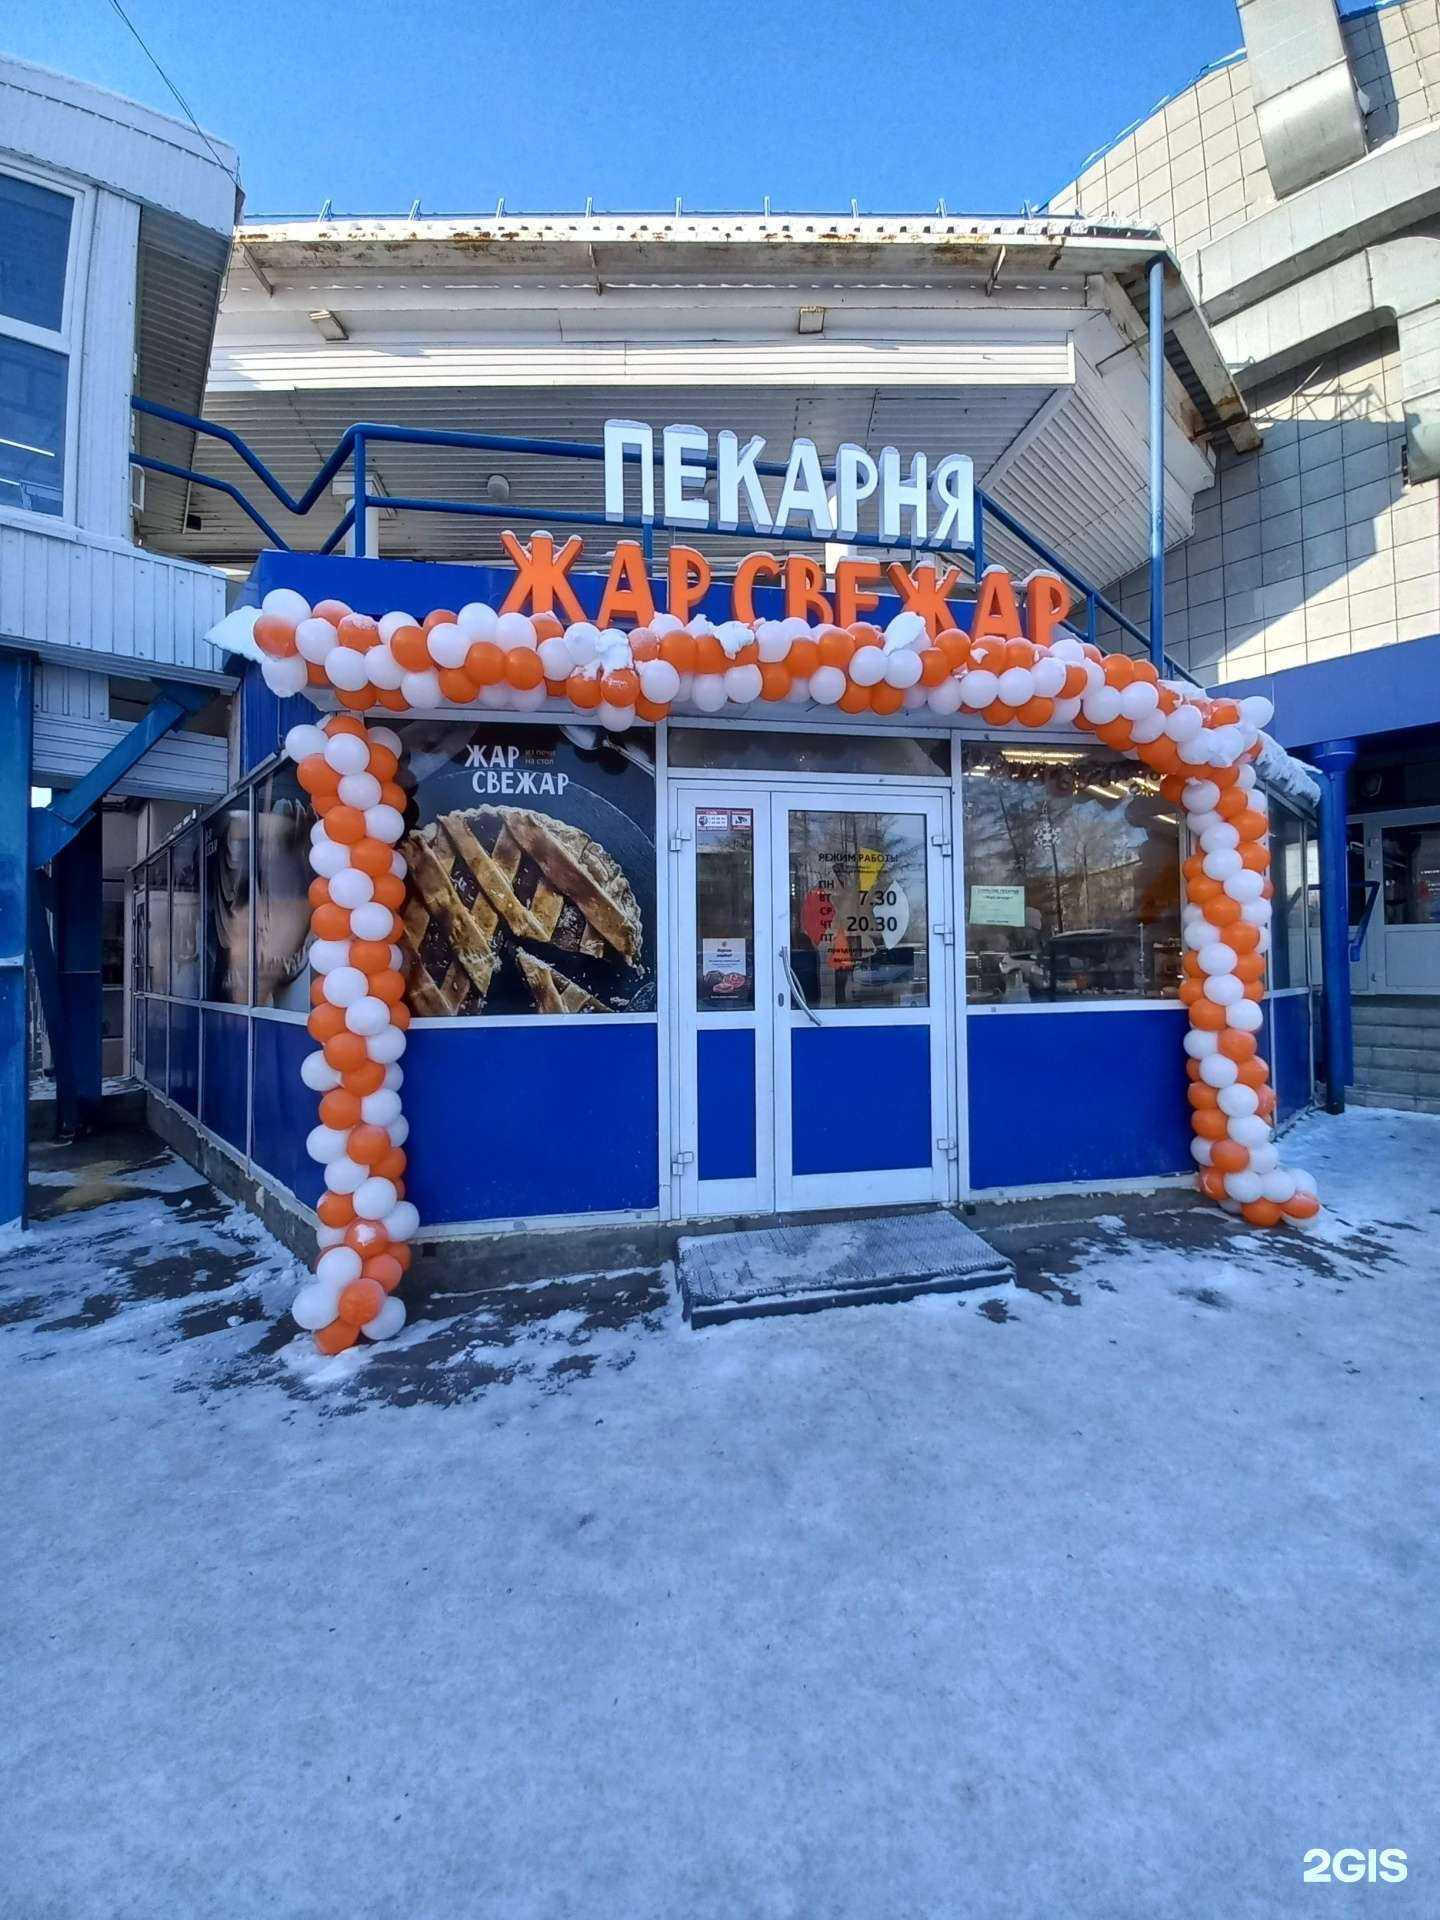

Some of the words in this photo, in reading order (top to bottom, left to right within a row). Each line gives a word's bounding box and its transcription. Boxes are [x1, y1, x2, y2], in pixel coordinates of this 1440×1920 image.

[604, 419, 975, 551] ПЕКАРНЯ
[499, 529, 711, 629] ЖАР
[464, 744, 520, 769] ЖАР
[472, 770, 570, 796] СВЕЖАР
[818, 853, 856, 862] РЕЖИМ
[858, 854, 898, 863] РАБОТЫ
[818, 880, 834, 889] ПН
[819, 893, 832, 902] ВТ
[858, 890, 897, 906] 7.30
[820, 906, 833, 916] СР
[820, 920, 833, 930] ЧТ
[846, 916, 898, 932] 20.30
[820, 933, 834, 942] ПТ
